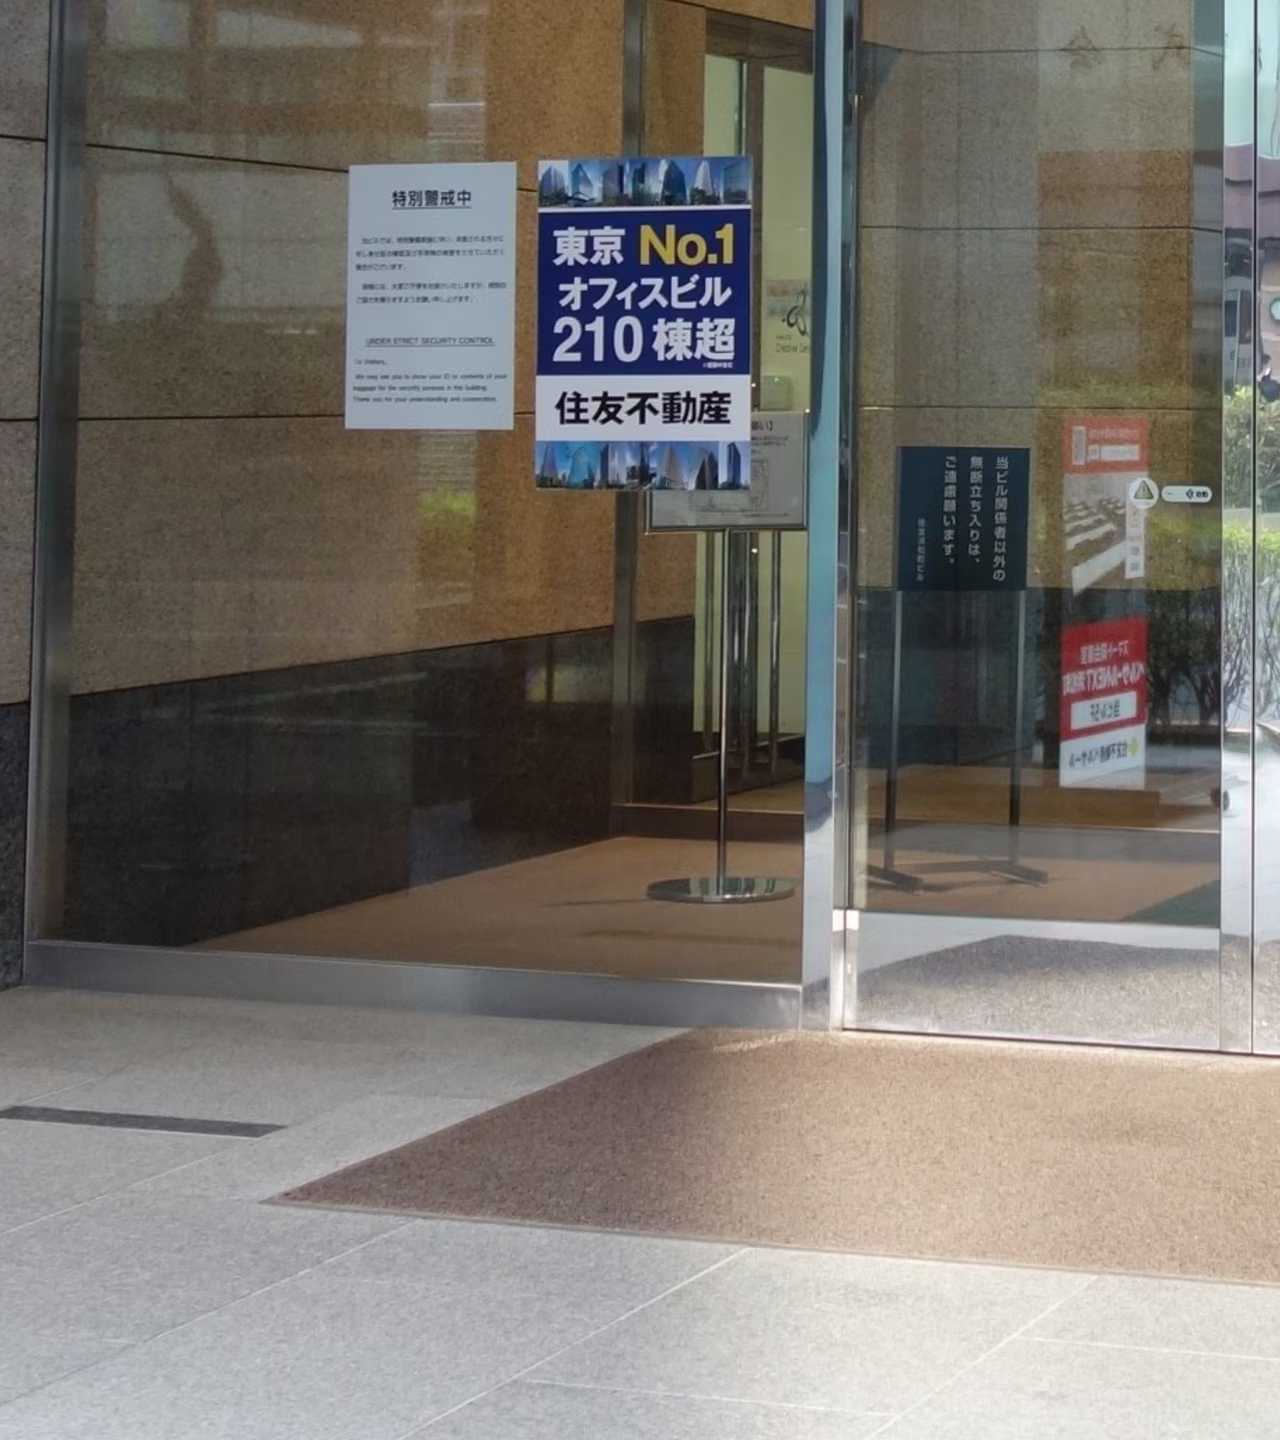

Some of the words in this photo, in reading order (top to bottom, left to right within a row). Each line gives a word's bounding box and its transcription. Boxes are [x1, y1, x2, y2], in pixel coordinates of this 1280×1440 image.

[392, 190, 472, 207] 特別警戒中
[553, 226, 625, 266] 東京
[640, 224, 734, 266] No.1
[558, 274, 733, 311] オフィスビル
[555, 391, 732, 425] 住友不動産
[993, 456, 1008, 581] 当ビル関係者以外の
